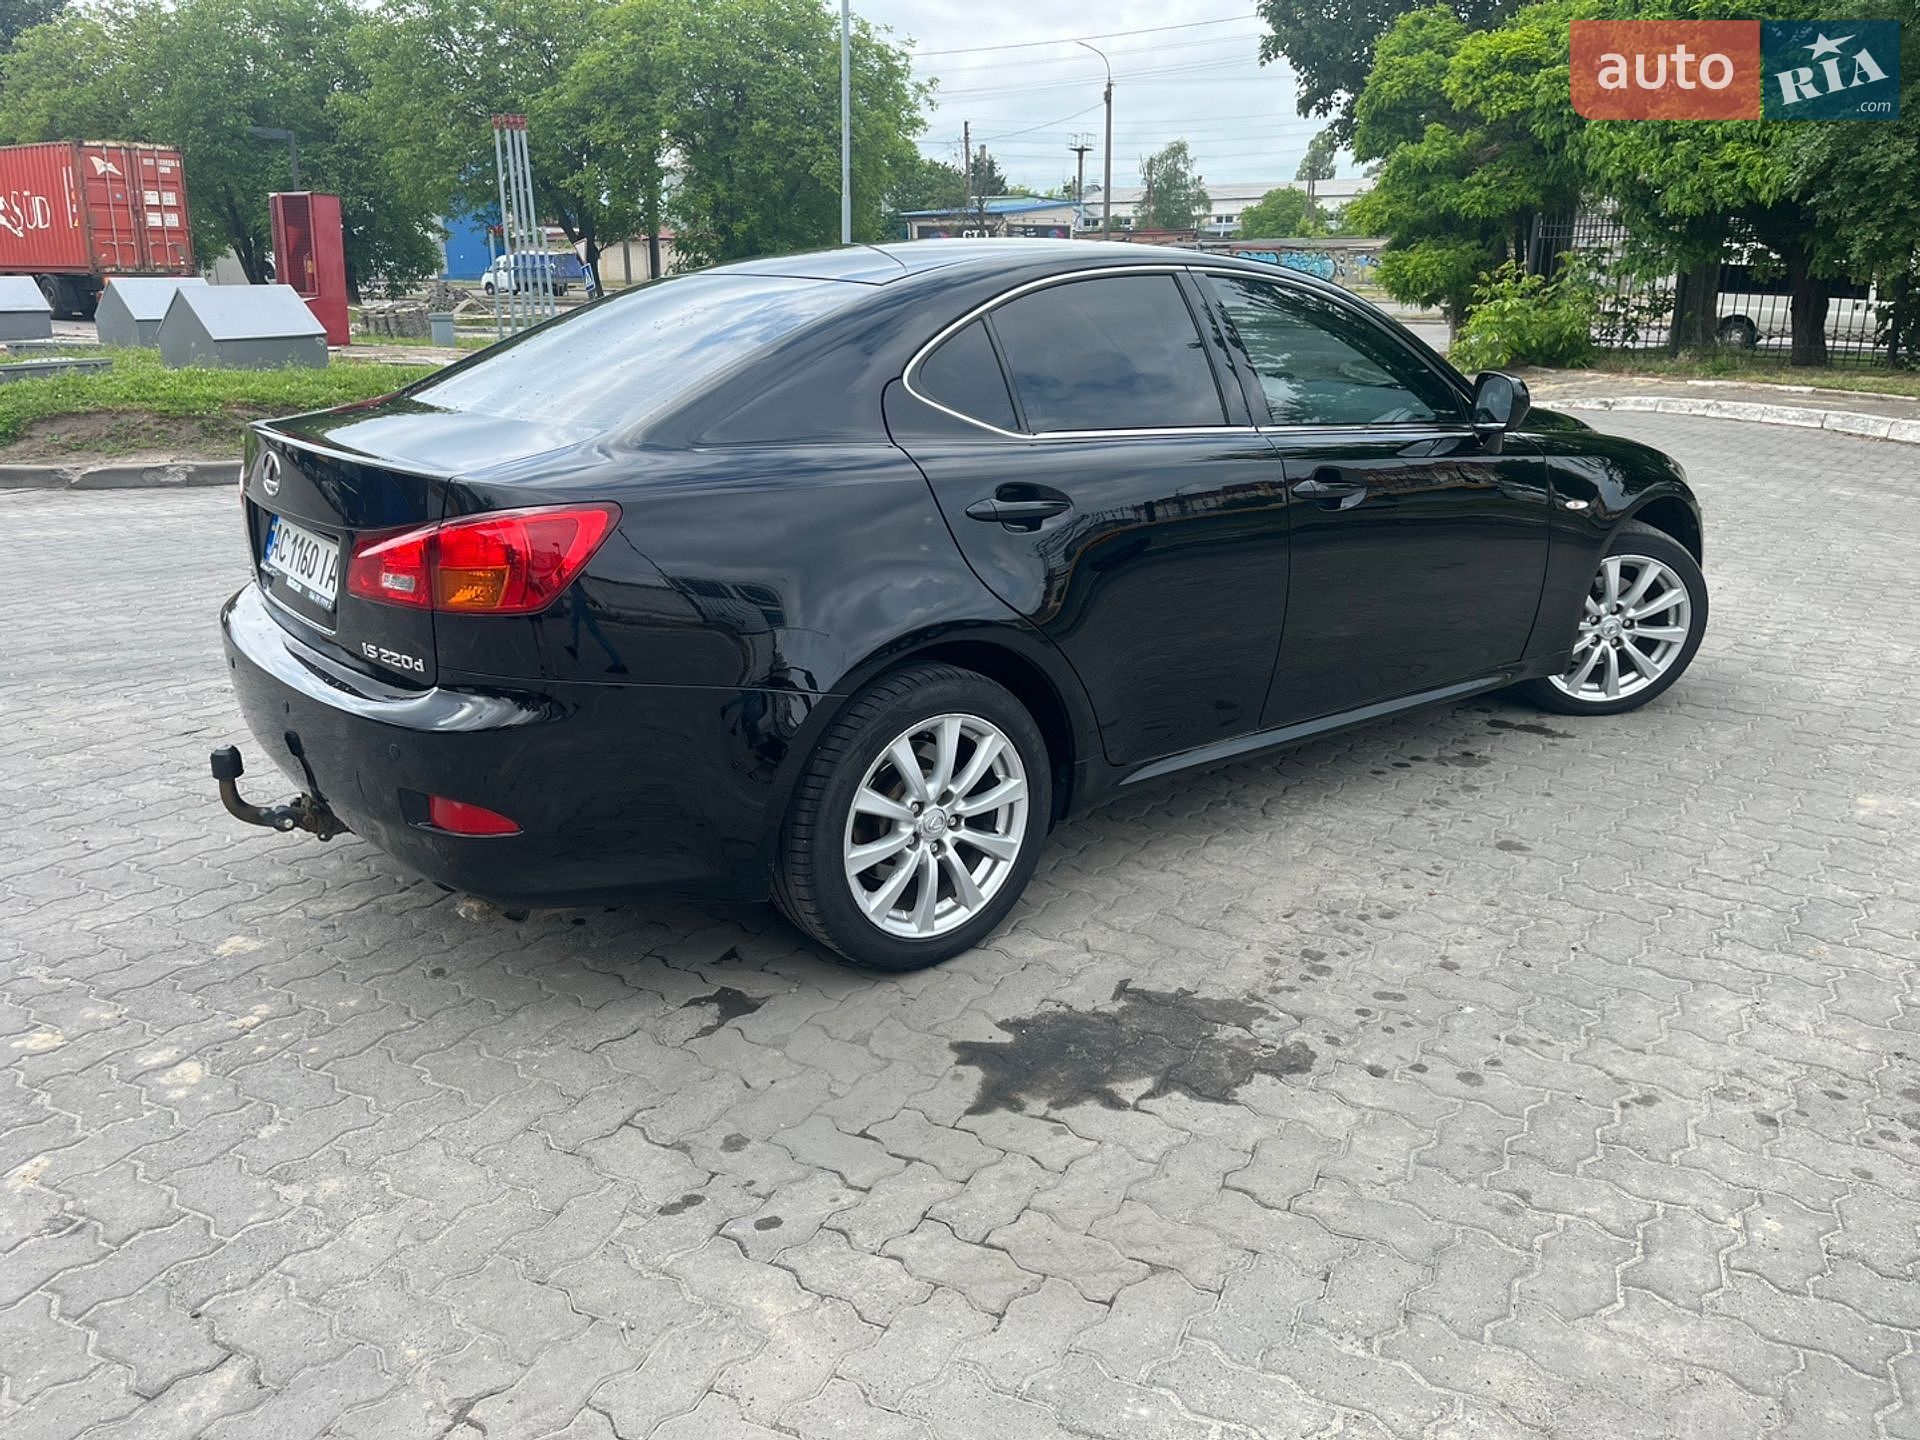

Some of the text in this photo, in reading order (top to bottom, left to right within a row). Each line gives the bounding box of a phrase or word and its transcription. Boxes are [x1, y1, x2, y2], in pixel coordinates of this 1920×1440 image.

[270, 524, 291, 562] AC
[289, 533, 319, 579] 1160
[362, 642, 424, 672] IS 220d
